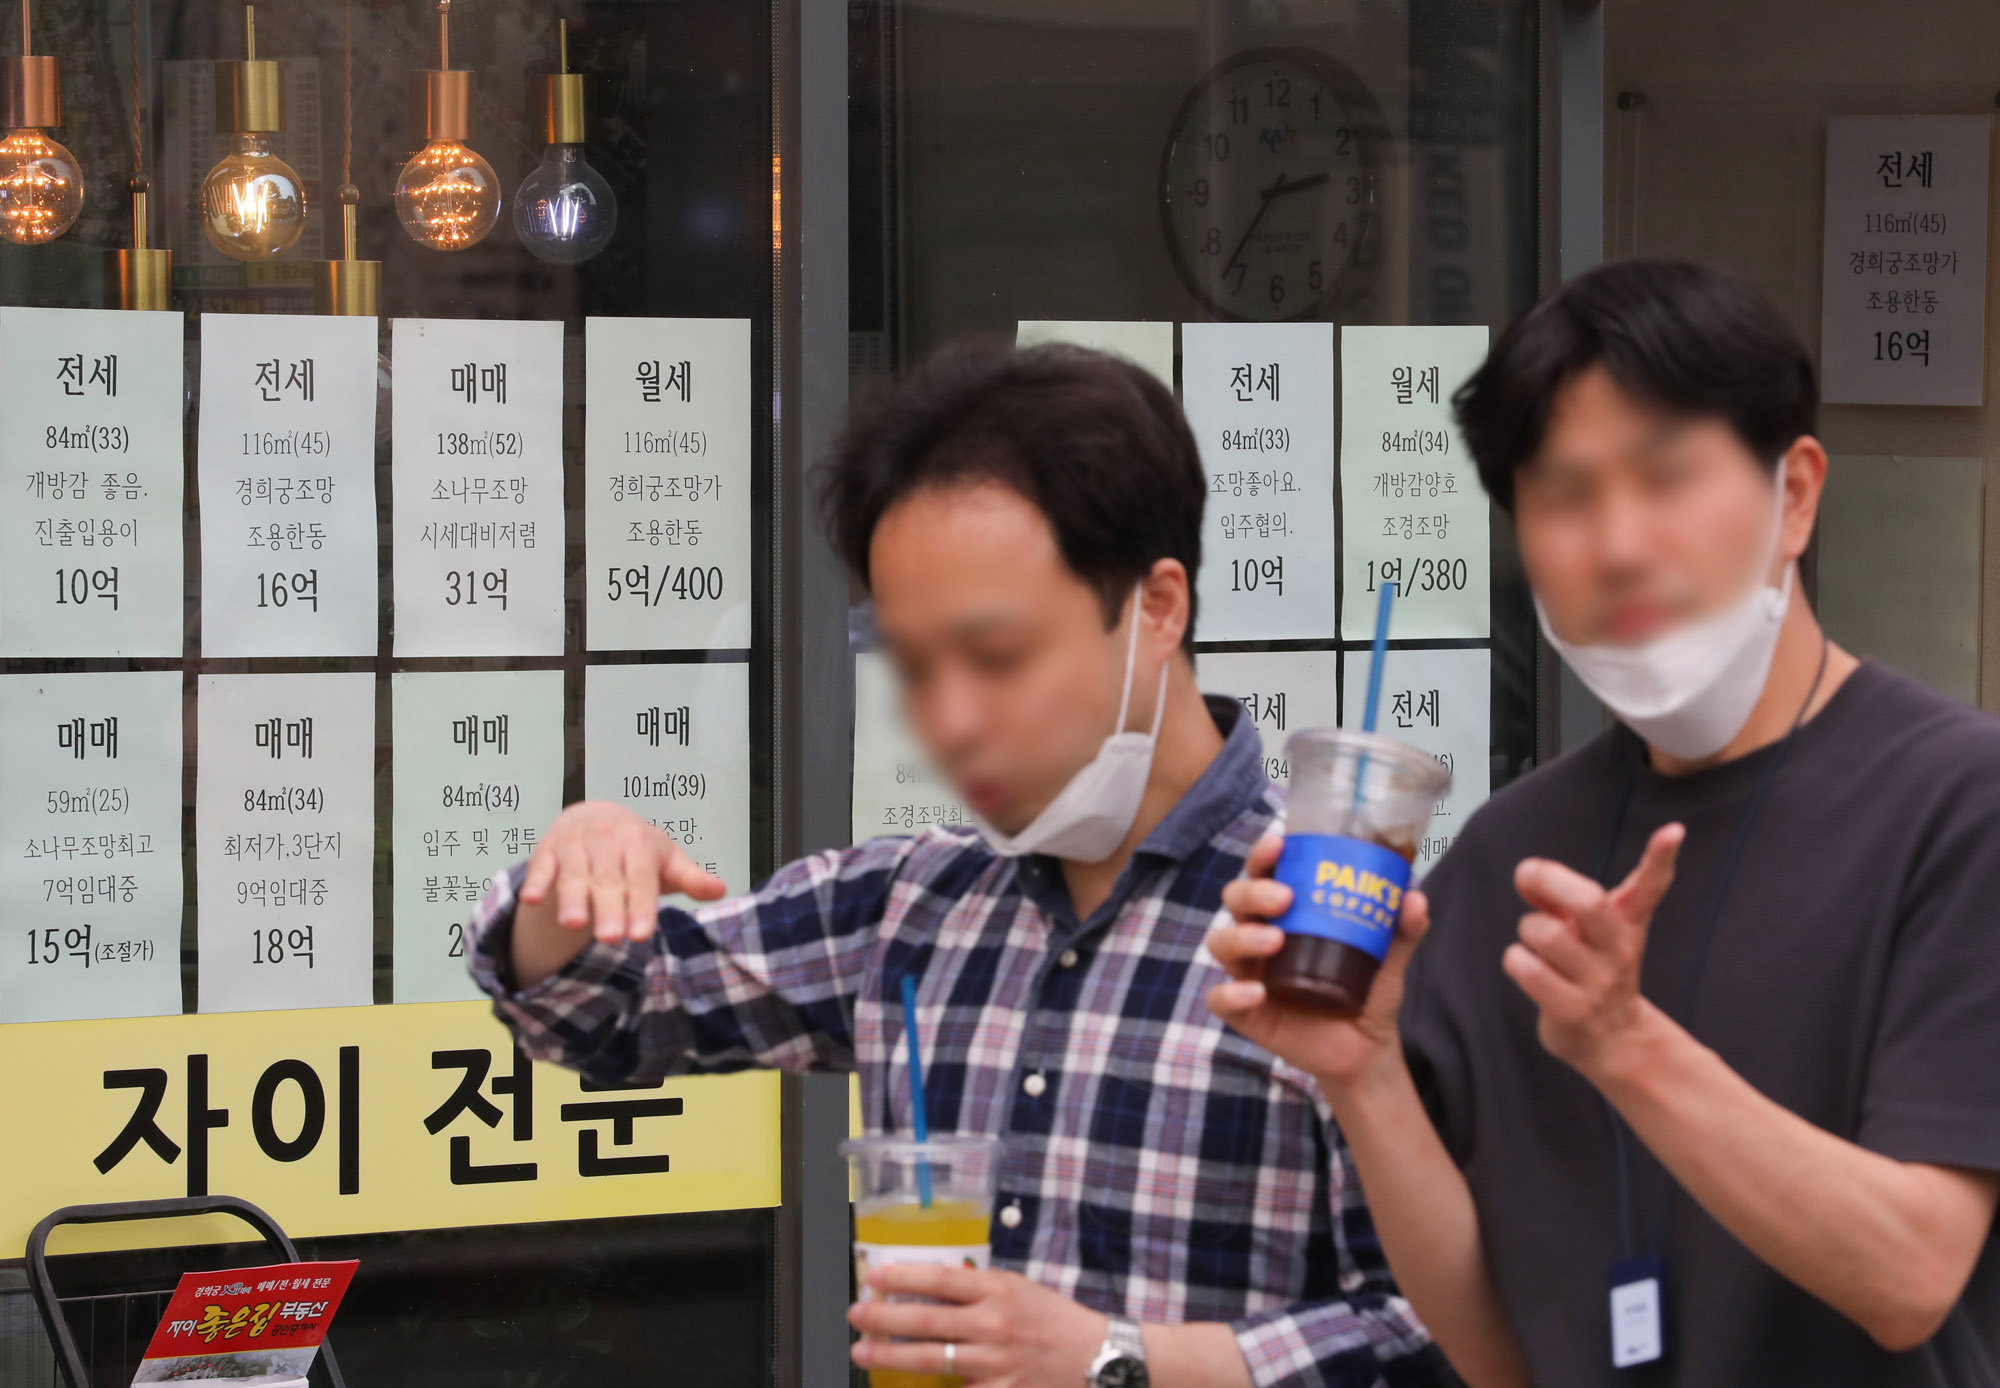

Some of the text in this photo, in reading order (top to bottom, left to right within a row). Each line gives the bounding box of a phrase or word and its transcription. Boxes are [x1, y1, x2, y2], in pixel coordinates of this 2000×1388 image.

[1877, 151, 1933, 188] 전세
[1850, 251, 1958, 275] 경희궁조망가
[1866, 290, 1938, 313] 조용한동
[1874, 329, 1929, 367] 16억
[57, 354, 117, 397] 전세
[255, 358, 314, 402] 전세
[451, 363, 506, 404] 매매
[636, 360, 690, 403] 월세
[1230, 363, 1279, 402] 전세
[1391, 366, 1439, 404] 월세
[26, 471, 147, 500] 개방감 좋음.
[236, 476, 335, 505] 경희궁조망
[431, 477, 528, 504] 소나무조망
[610, 475, 722, 501] 경희궁조망가
[1210, 470, 1301, 497] 조망좋아요.
[1374, 472, 1458, 497] 개방감양호
[35, 518, 136, 547] 진출입용이
[247, 522, 326, 551] 조용한동
[421, 522, 534, 549] 시세대비저렴
[627, 519, 702, 546] 조용한동
[1221, 512, 1292, 539] 입주협의.
[1382, 514, 1449, 540] 조경조망
[56, 566, 118, 611] 10억
[258, 569, 317, 612] 16억
[446, 568, 507, 611] 31억
[608, 565, 723, 607] 5억/400
[1232, 556, 1282, 596] 10억
[1366, 558, 1468, 597] 1억/380
[637, 706, 689, 747] 매매
[1392, 689, 1439, 728] 전세
[57, 717, 117, 760] 매매
[255, 717, 312, 760] 매매
[452, 714, 508, 756] 매매
[24, 833, 154, 860] 소나무조망최고
[224, 832, 340, 861] 최저가,3단지
[424, 830, 461, 856] 입주
[473, 828, 488, 855] 및
[44, 875, 138, 905] 7억임대중
[238, 878, 328, 907] 9억임대중
[253, 925, 313, 969] 18억
[93, 1046, 684, 1197] 자이 전문
[196, 1302, 282, 1344] 좋은집
[279, 1301, 329, 1321] 부동산
